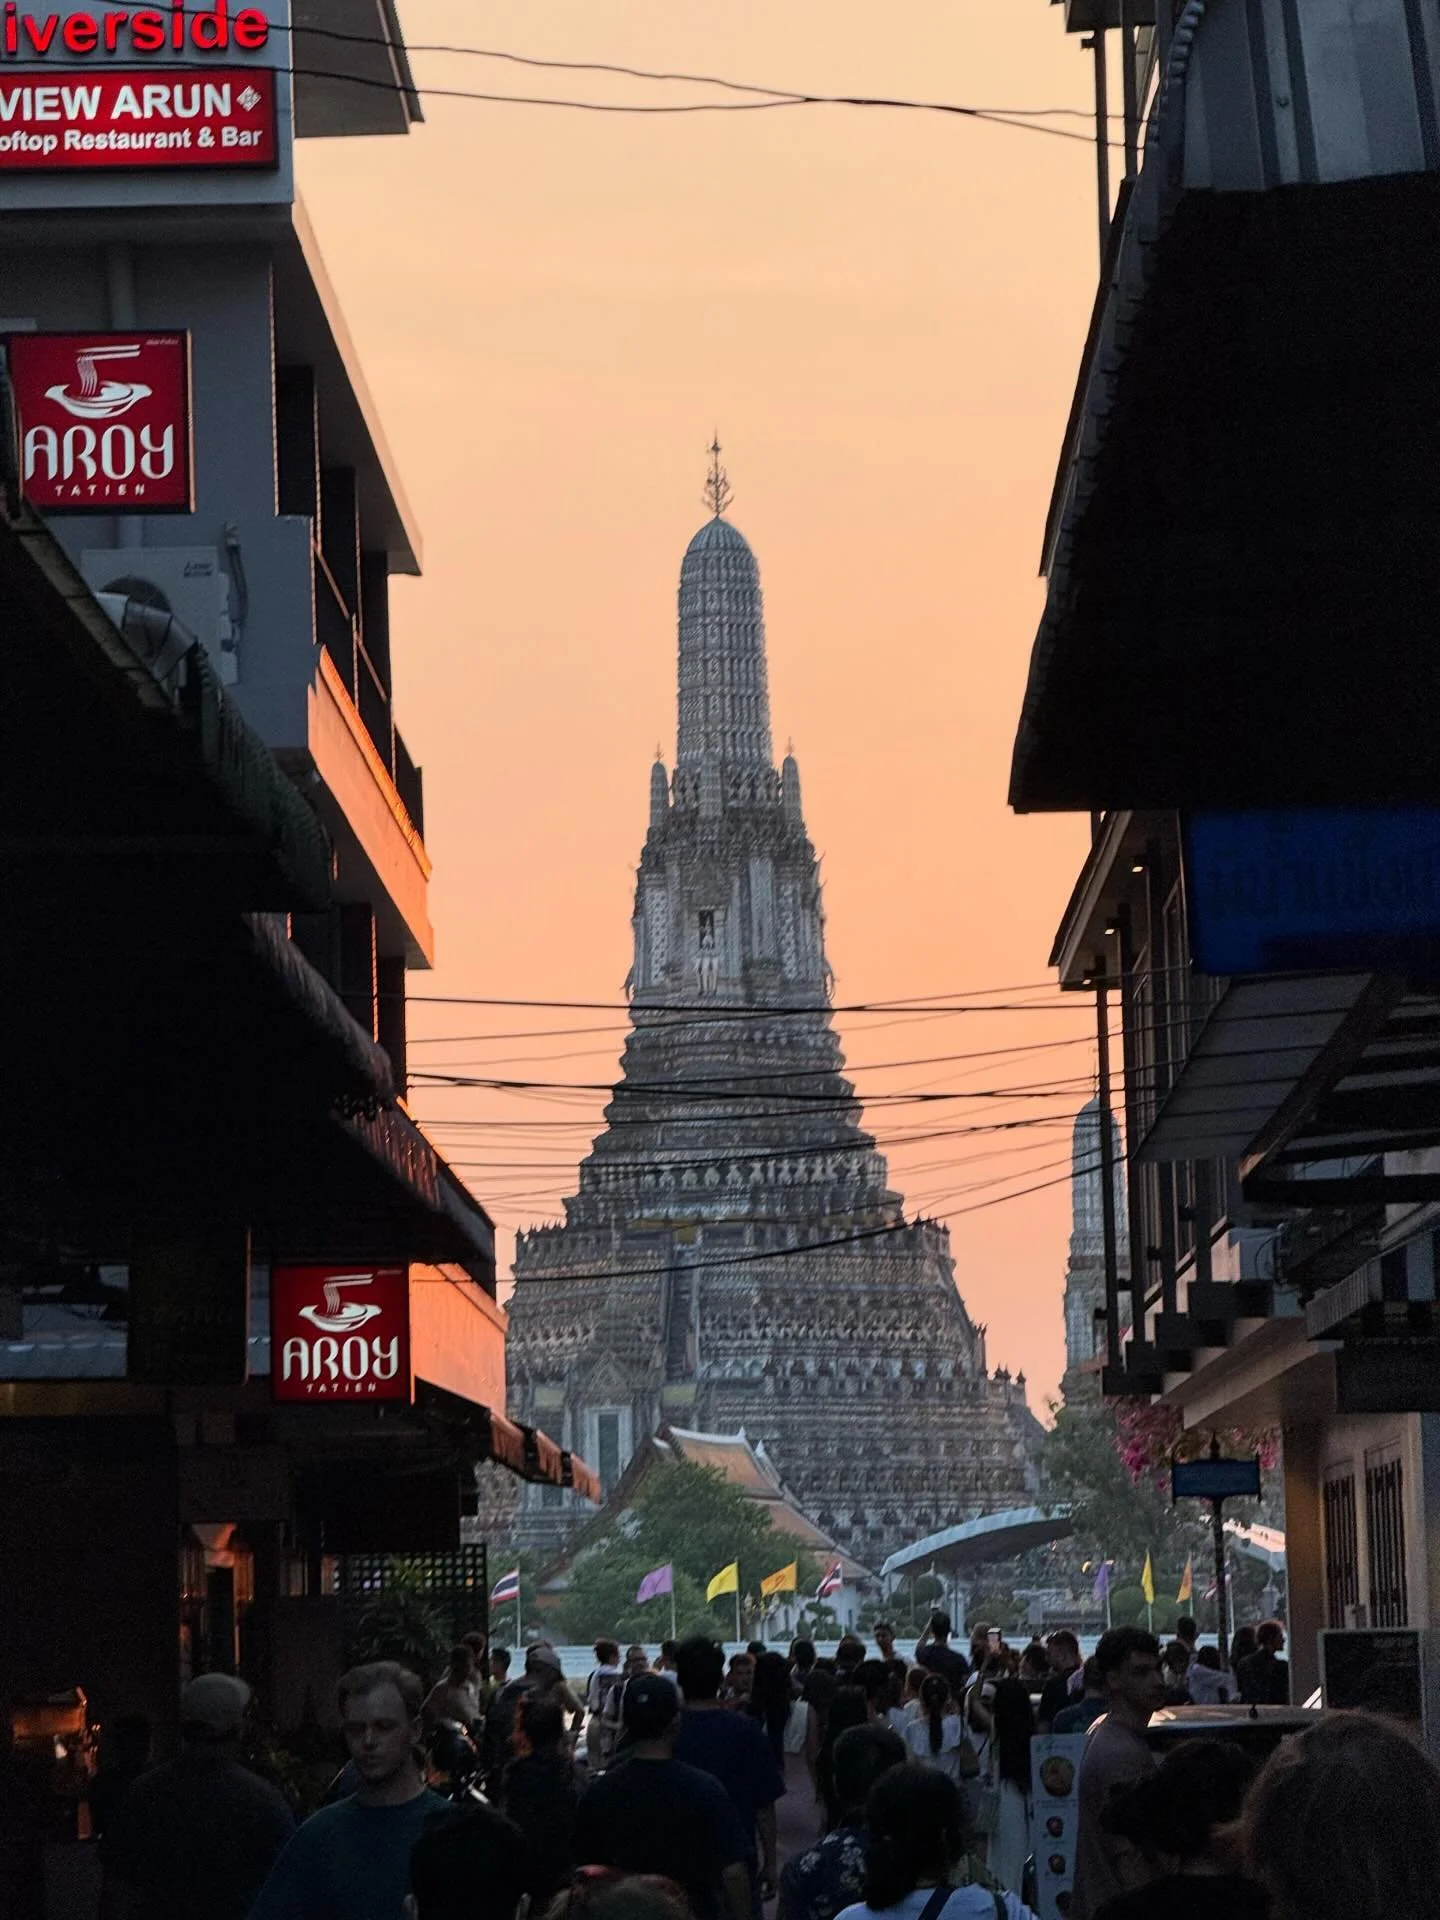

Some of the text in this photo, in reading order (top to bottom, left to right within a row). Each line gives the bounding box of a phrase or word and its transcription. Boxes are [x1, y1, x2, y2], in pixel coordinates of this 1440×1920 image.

[0, 83, 231, 121] VIEW ARUN
[64, 127, 192, 152] Restaurant
[197, 129, 215, 148] &
[221, 127, 263, 147] Bar
[24, 424, 174, 481] AROY
[282, 1336, 400, 1382] AROY
